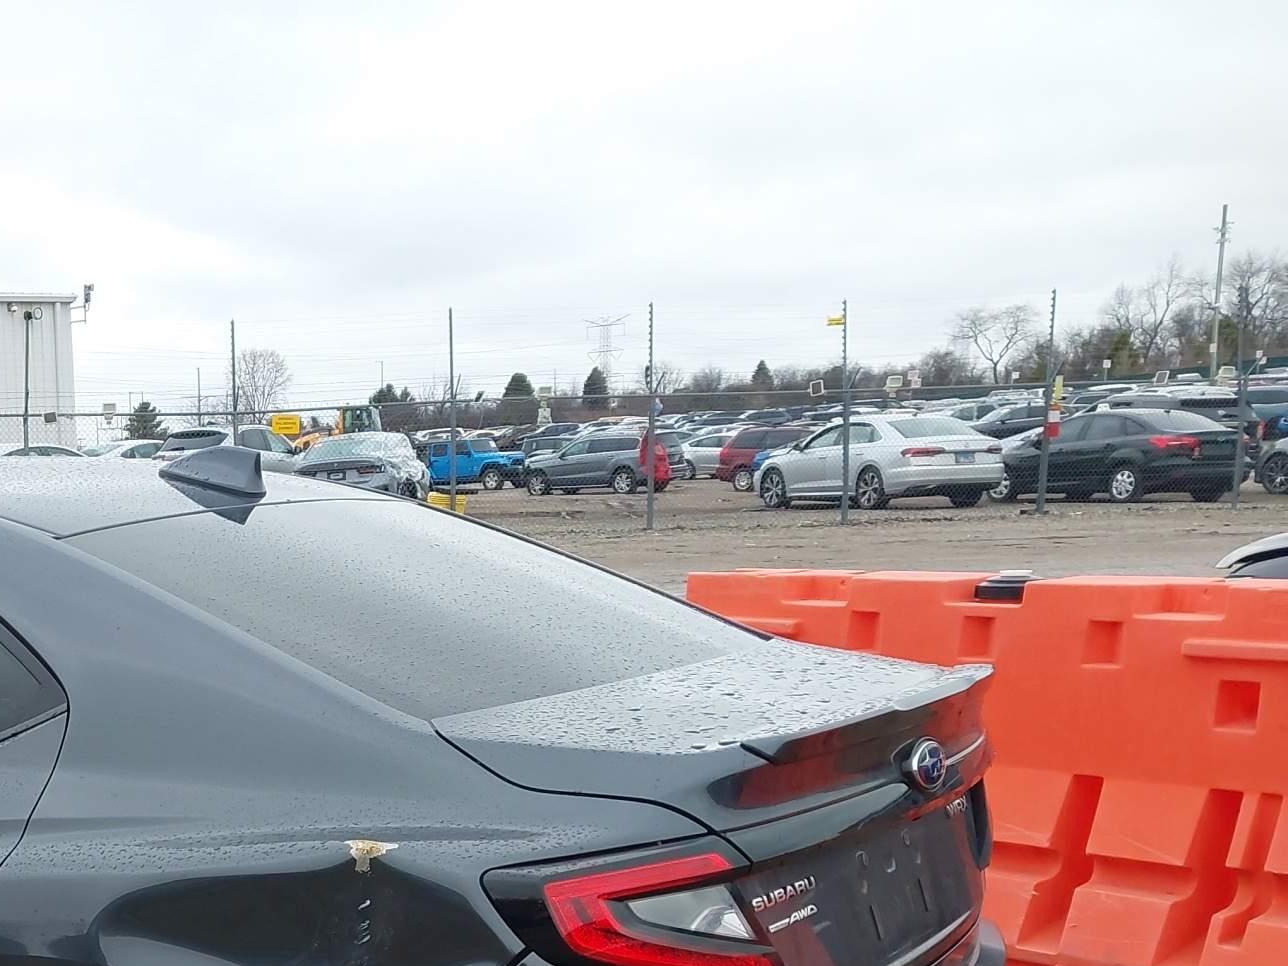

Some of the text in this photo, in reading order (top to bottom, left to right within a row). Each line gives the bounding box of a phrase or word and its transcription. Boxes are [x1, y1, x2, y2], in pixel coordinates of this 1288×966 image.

[945, 795, 967, 816] WRX
[752, 876, 816, 912] SUBARU
[790, 904, 818, 925] AWD
